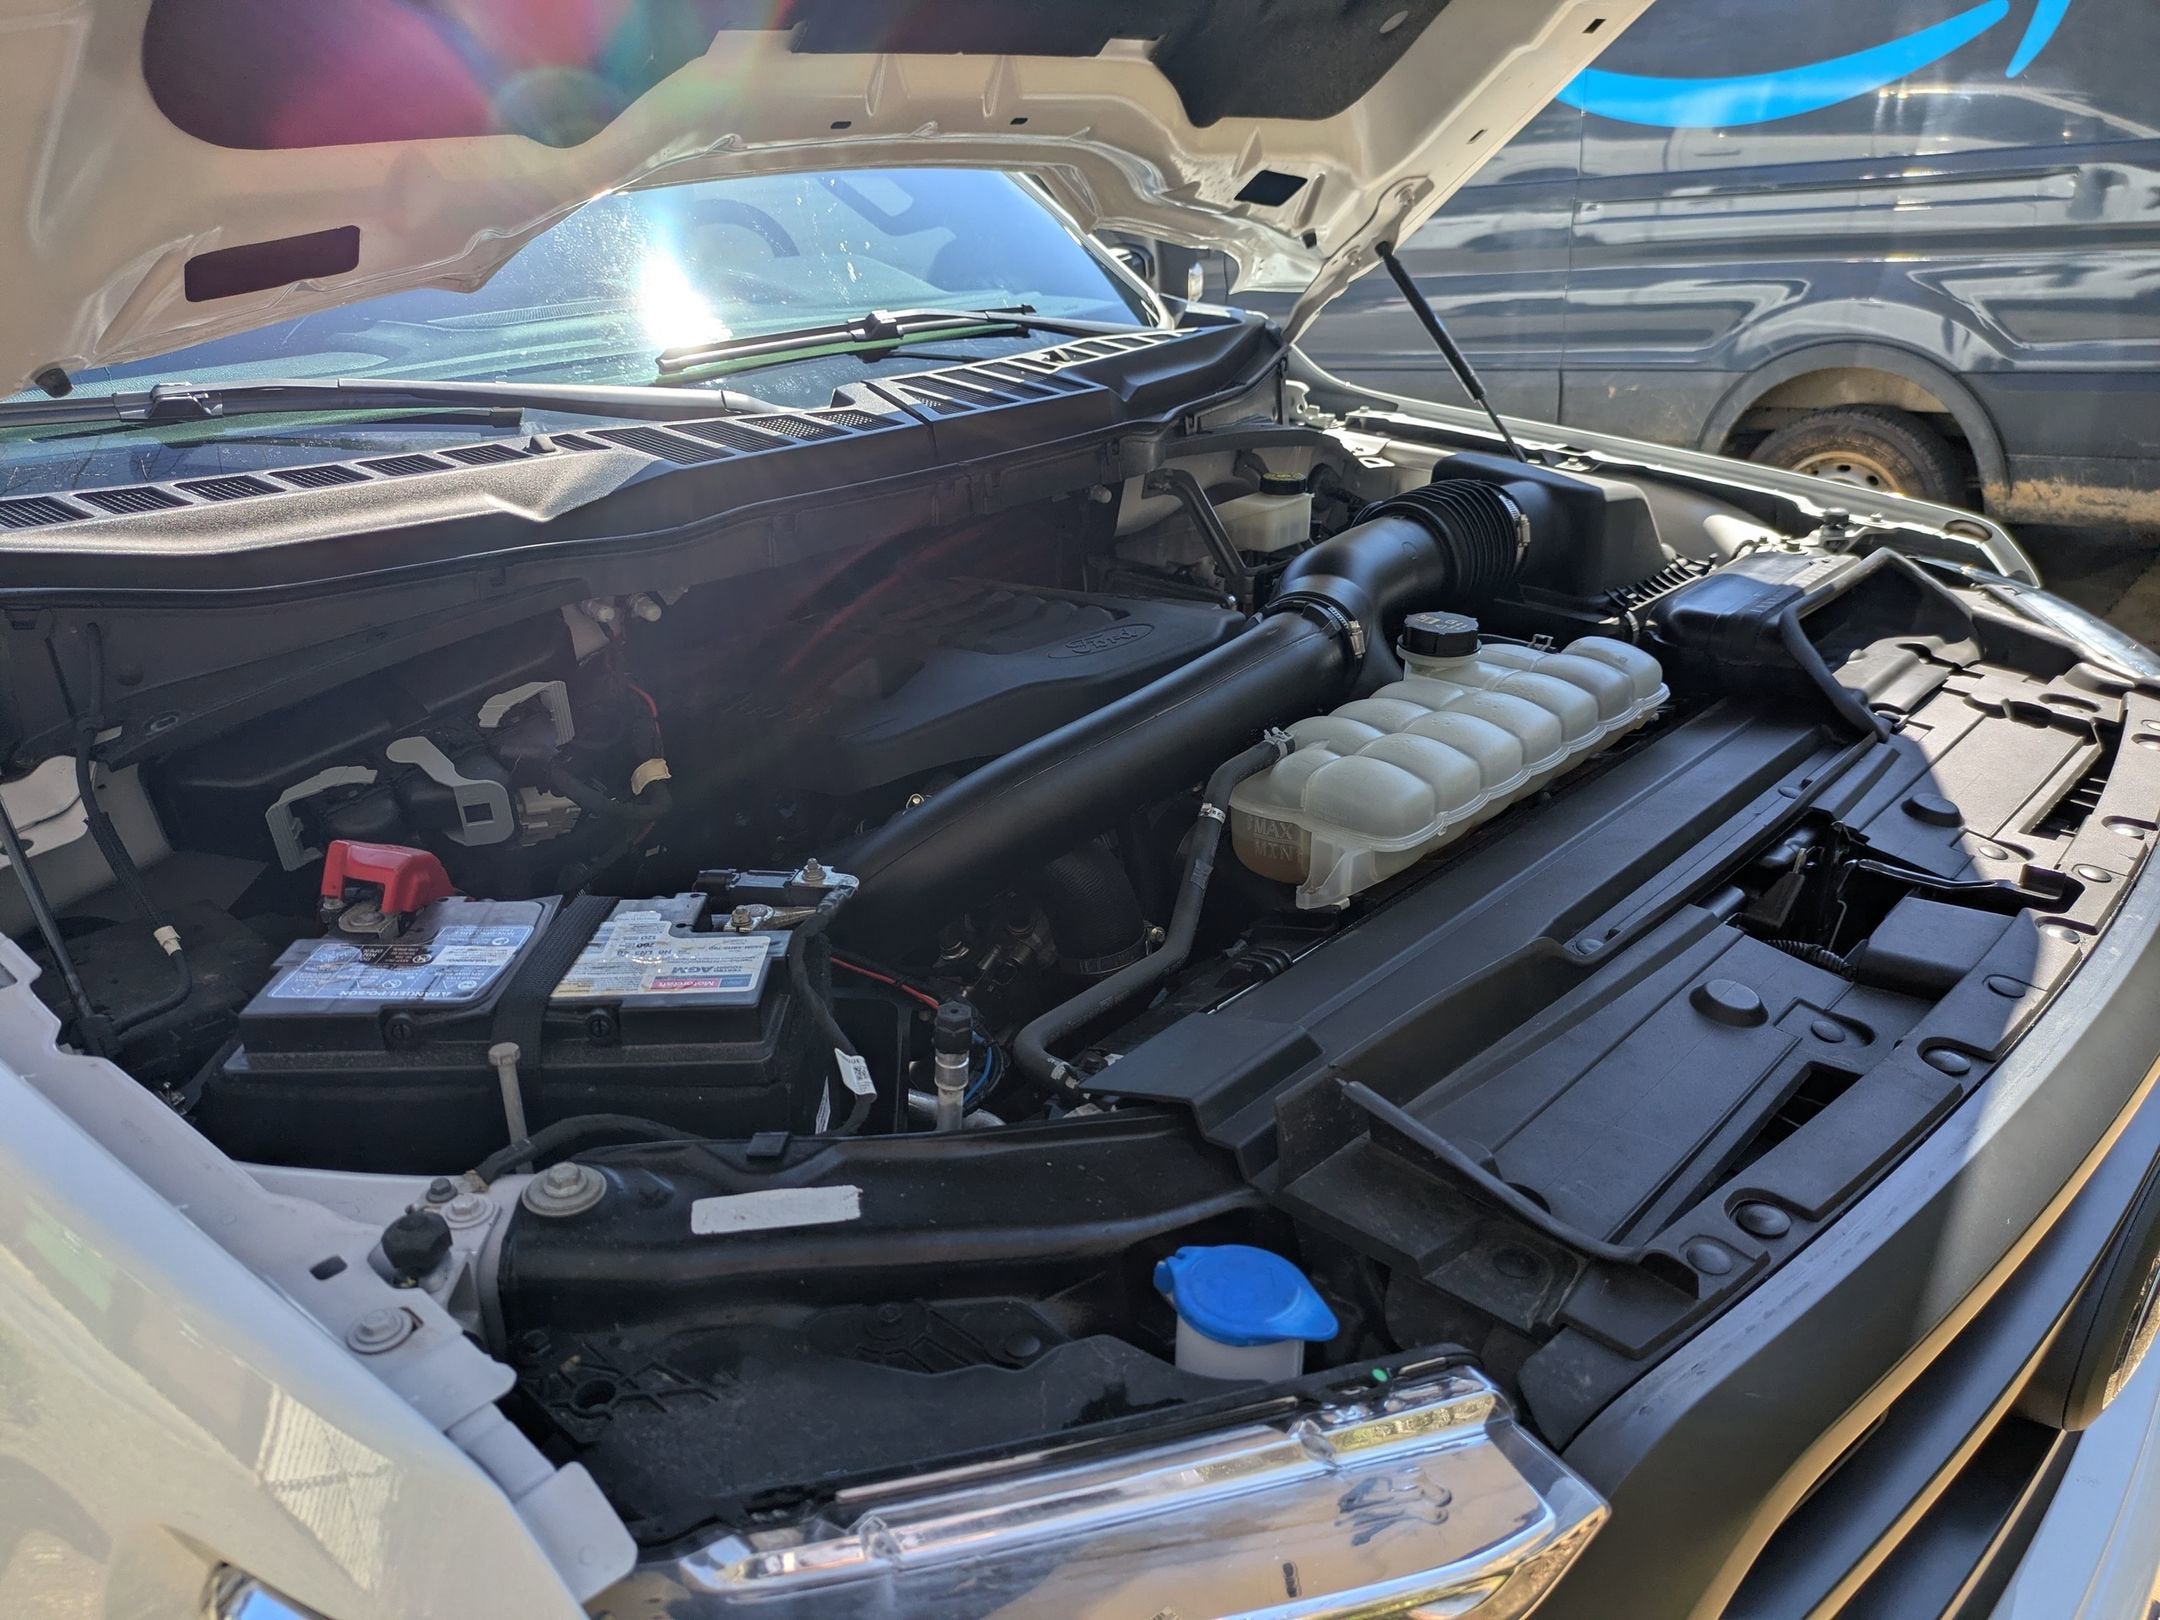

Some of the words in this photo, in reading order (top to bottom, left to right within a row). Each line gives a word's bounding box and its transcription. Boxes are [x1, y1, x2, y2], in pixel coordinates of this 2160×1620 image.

[1065, 627, 1139, 654] Ford
[1253, 816, 1293, 840] MAX
[1254, 840, 1294, 862] MIN
[672, 966, 716, 974] AGM
